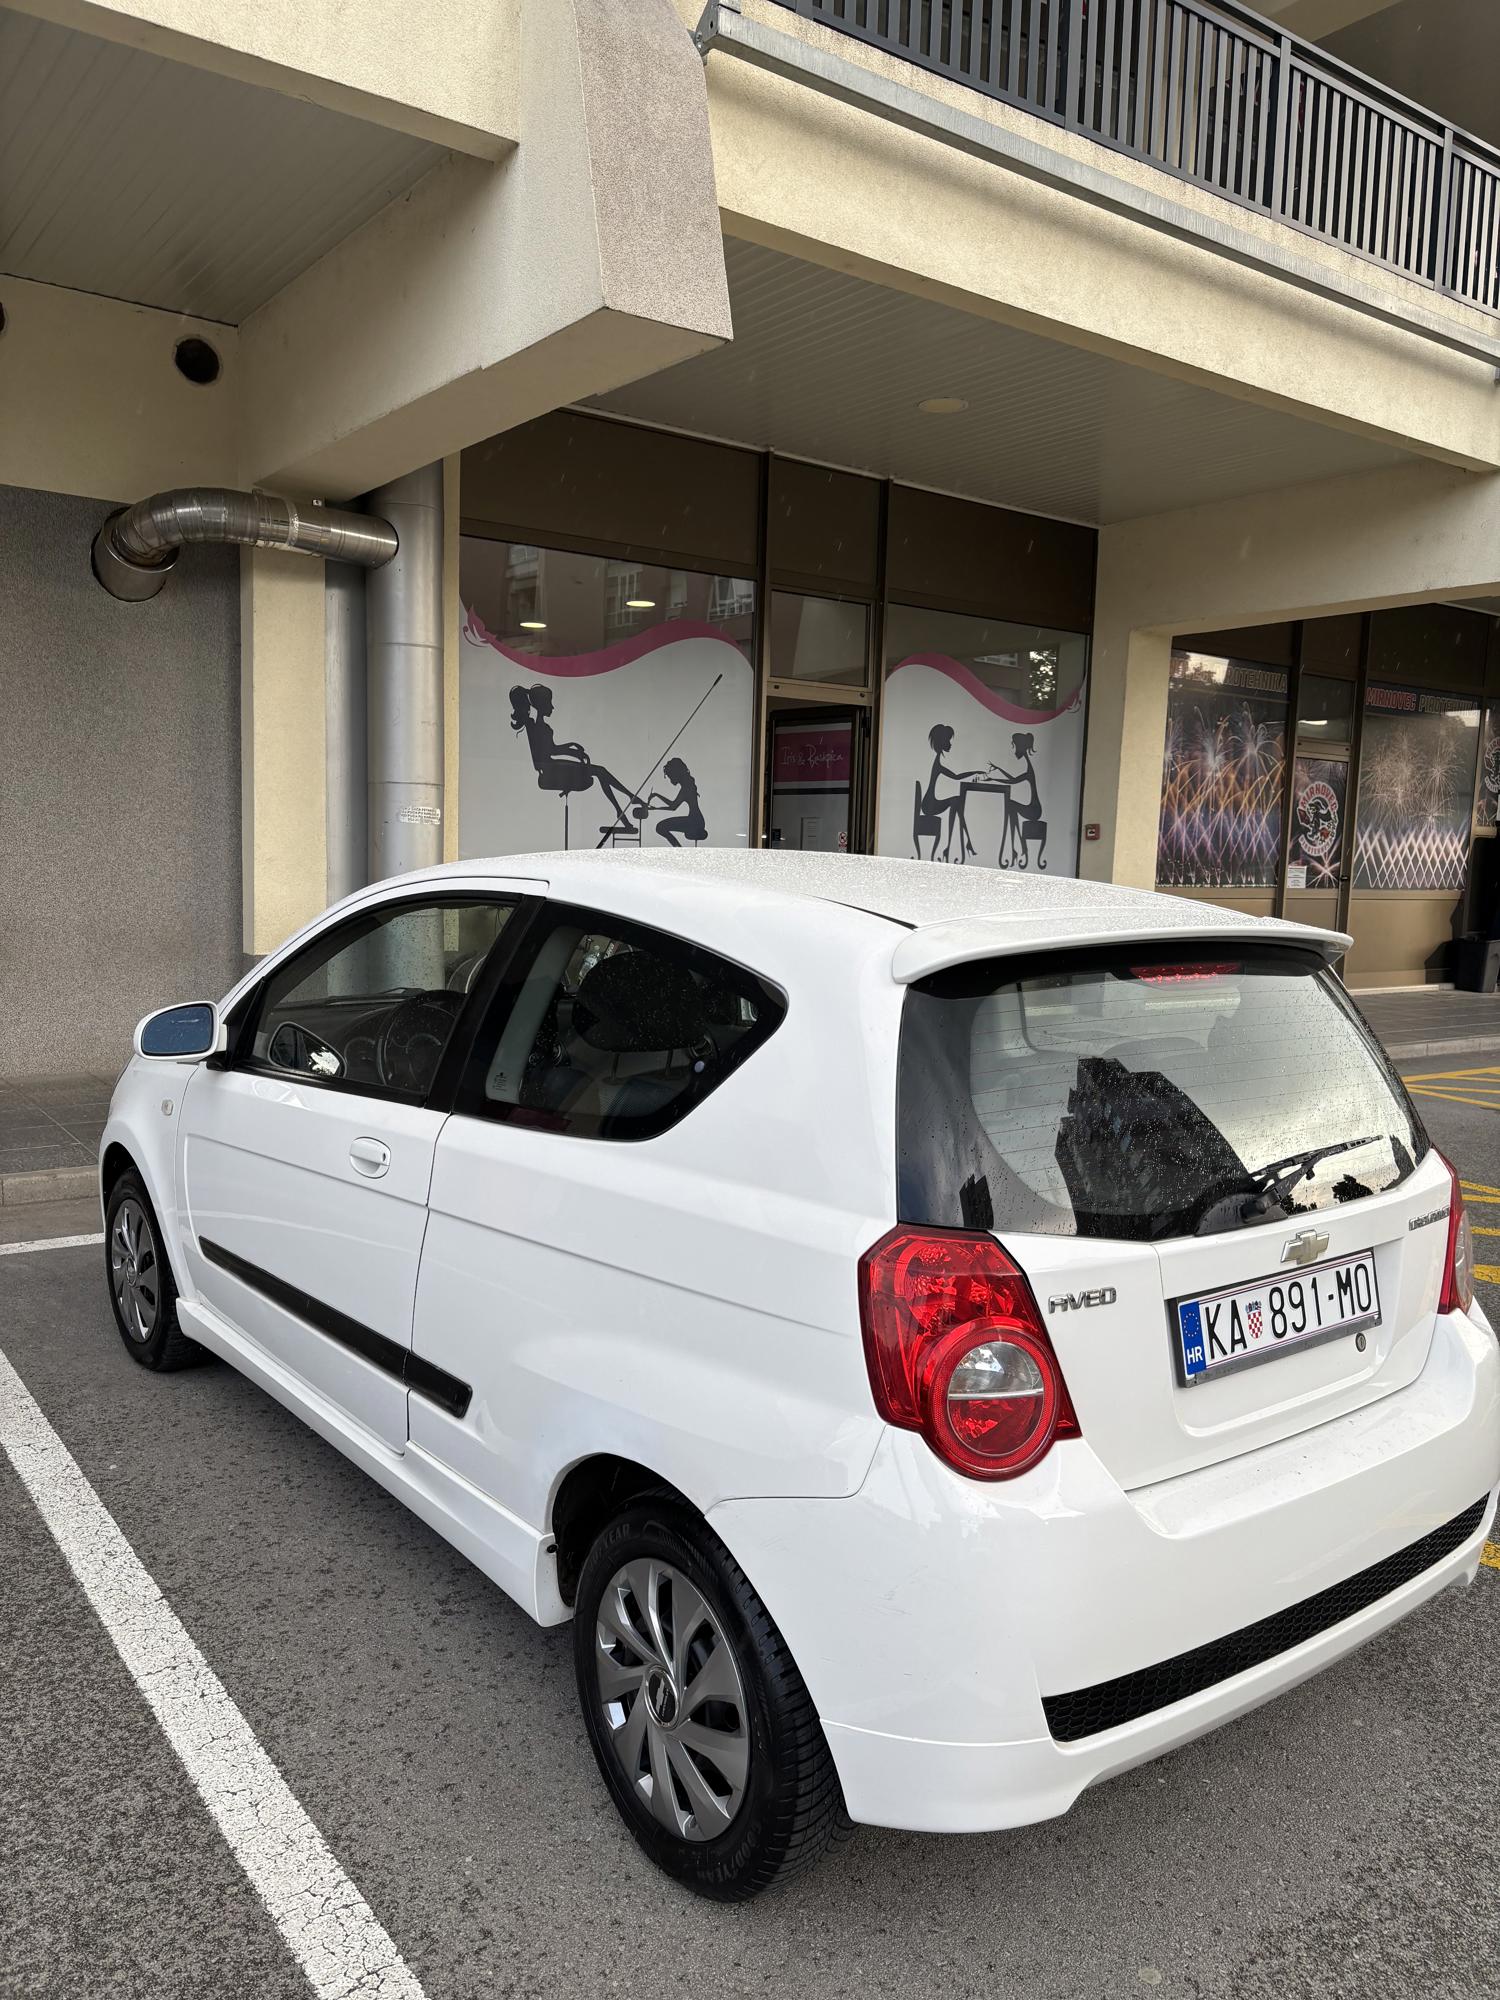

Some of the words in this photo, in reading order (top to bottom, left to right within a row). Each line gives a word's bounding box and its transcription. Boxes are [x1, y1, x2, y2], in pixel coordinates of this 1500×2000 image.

[1366, 686, 1417, 711] MIRNOVEC
[1300, 782, 1338, 812] MIRNOVEC
[1048, 1286, 1117, 1314] AVEO
[1205, 1299, 1247, 1360] KA
[1268, 1263, 1372, 1339] 891-MO
[1187, 1345, 1204, 1365] HR
